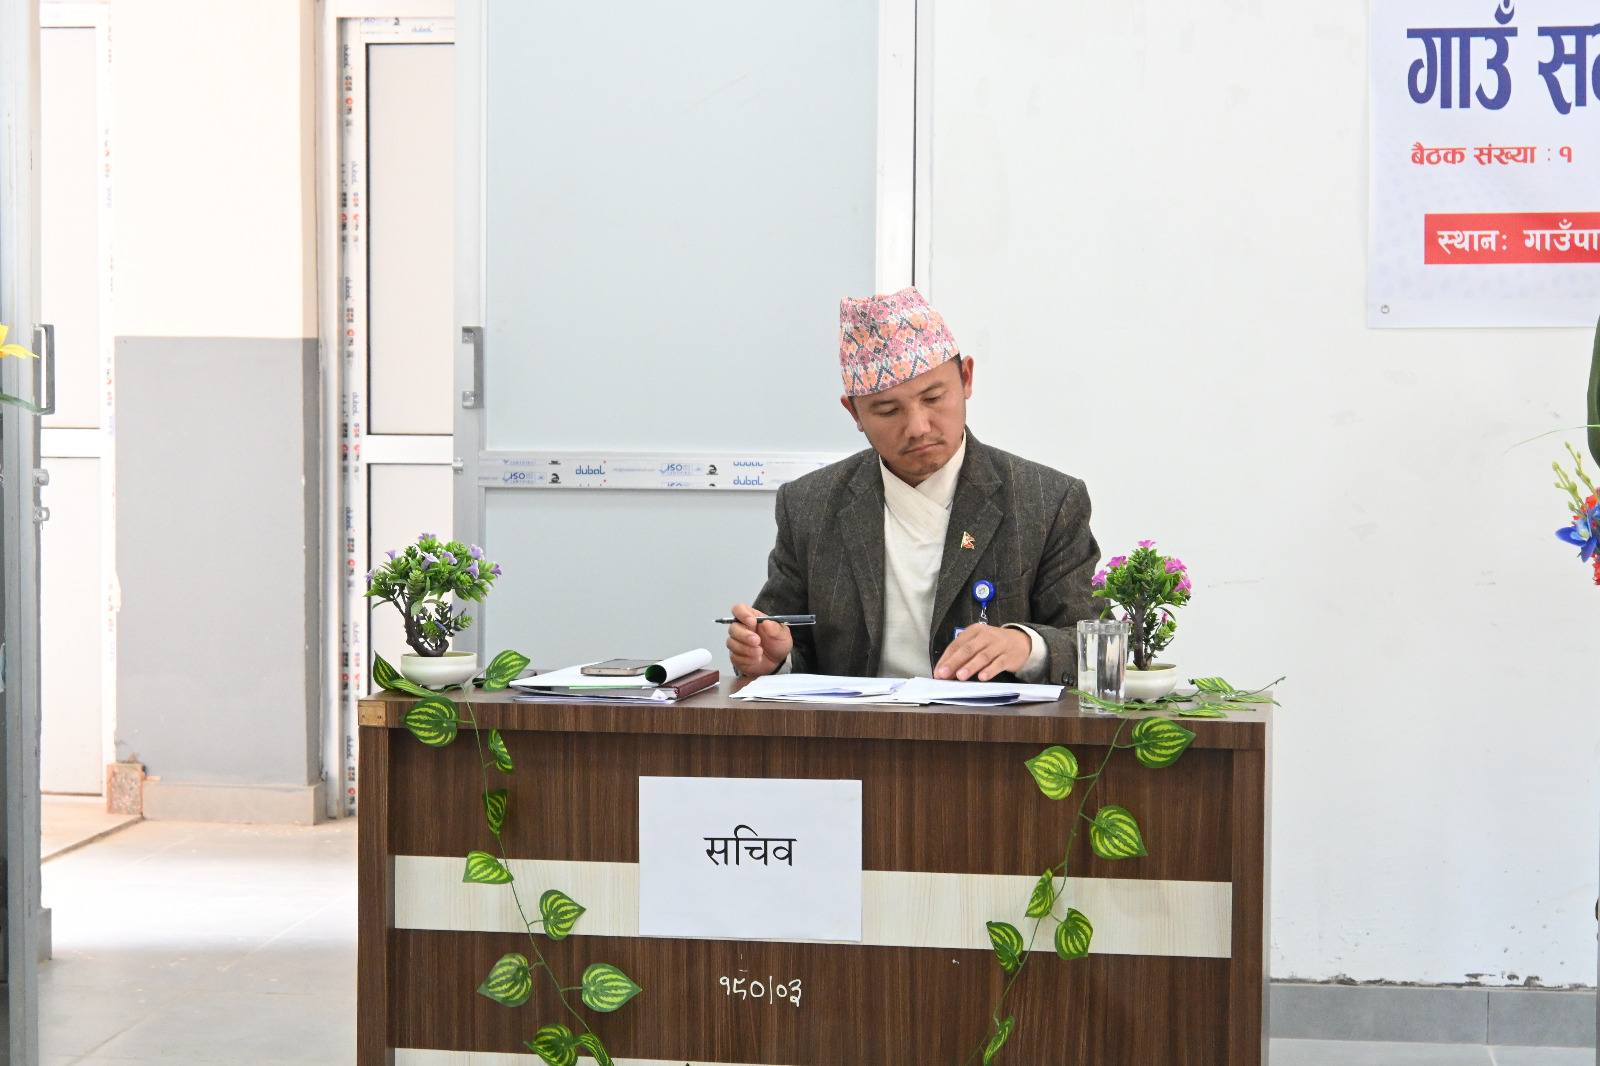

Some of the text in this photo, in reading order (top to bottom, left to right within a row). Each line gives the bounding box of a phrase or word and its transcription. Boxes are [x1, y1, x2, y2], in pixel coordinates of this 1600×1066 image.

[1407, 0, 1518, 110] गाउँ
[1411, 142, 1466, 165] बैठक
[1473, 143, 1537, 165] संख्या
[575, 465, 606, 475] dubal
[667, 463, 683, 472] ISO
[510, 472, 526, 481] ISO
[733, 475, 764, 486] dubal
[704, 824, 797, 866] सचिव
